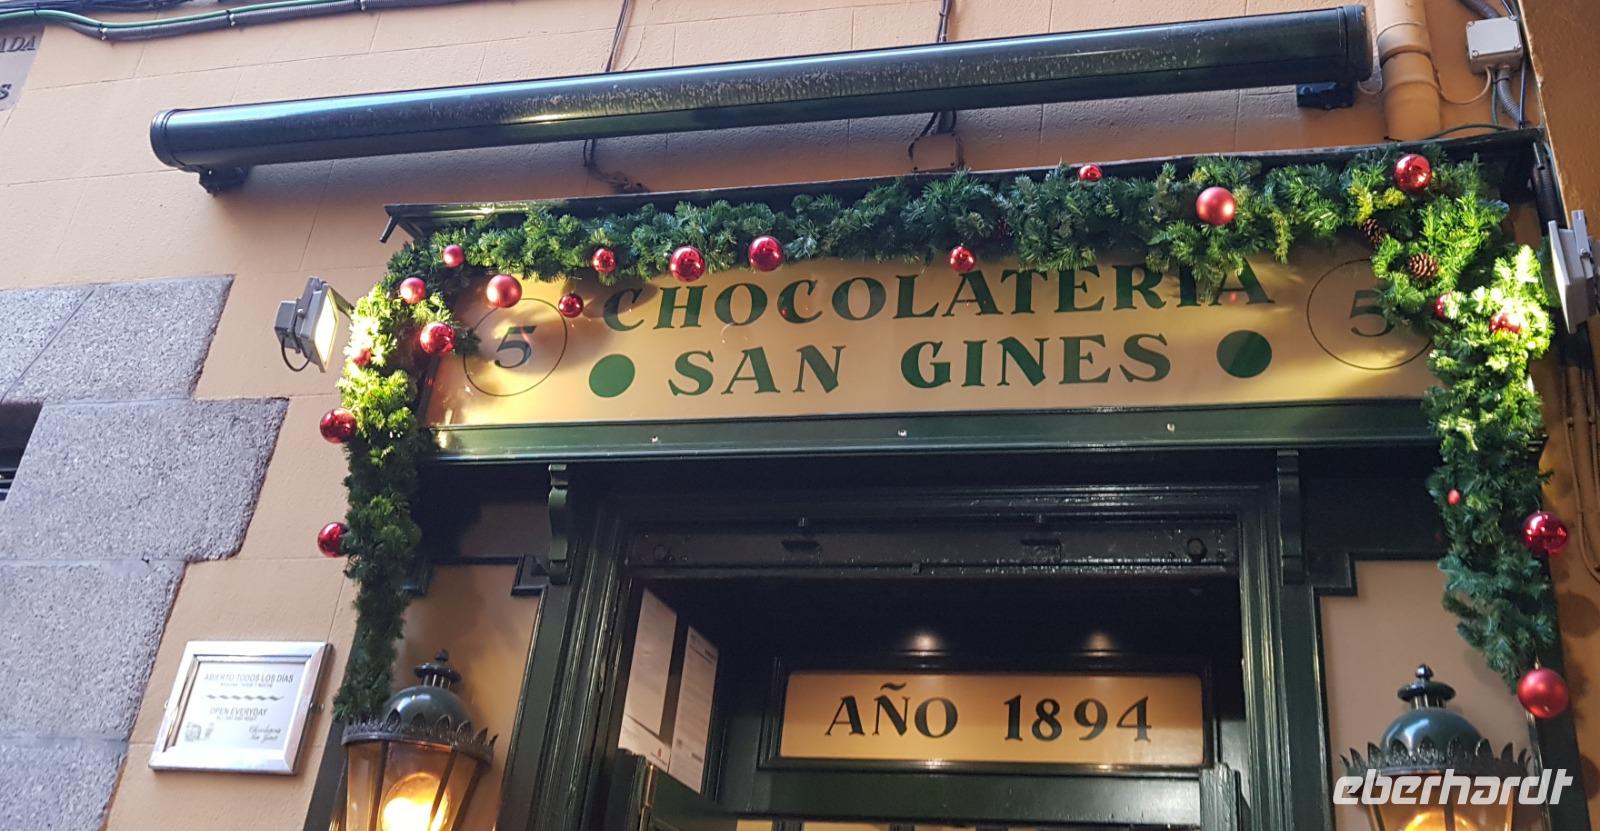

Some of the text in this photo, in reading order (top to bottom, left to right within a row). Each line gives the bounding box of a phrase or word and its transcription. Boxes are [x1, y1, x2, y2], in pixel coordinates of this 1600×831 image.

[603, 257, 1275, 332] CHOCOLATERIA
[1349, 289, 1394, 338] 5
[495, 325, 537, 369] 5
[668, 334, 1171, 396] SAN GINES
[261, 673, 276, 683] LOS
[825, 682, 1152, 742] AÑO 1894
